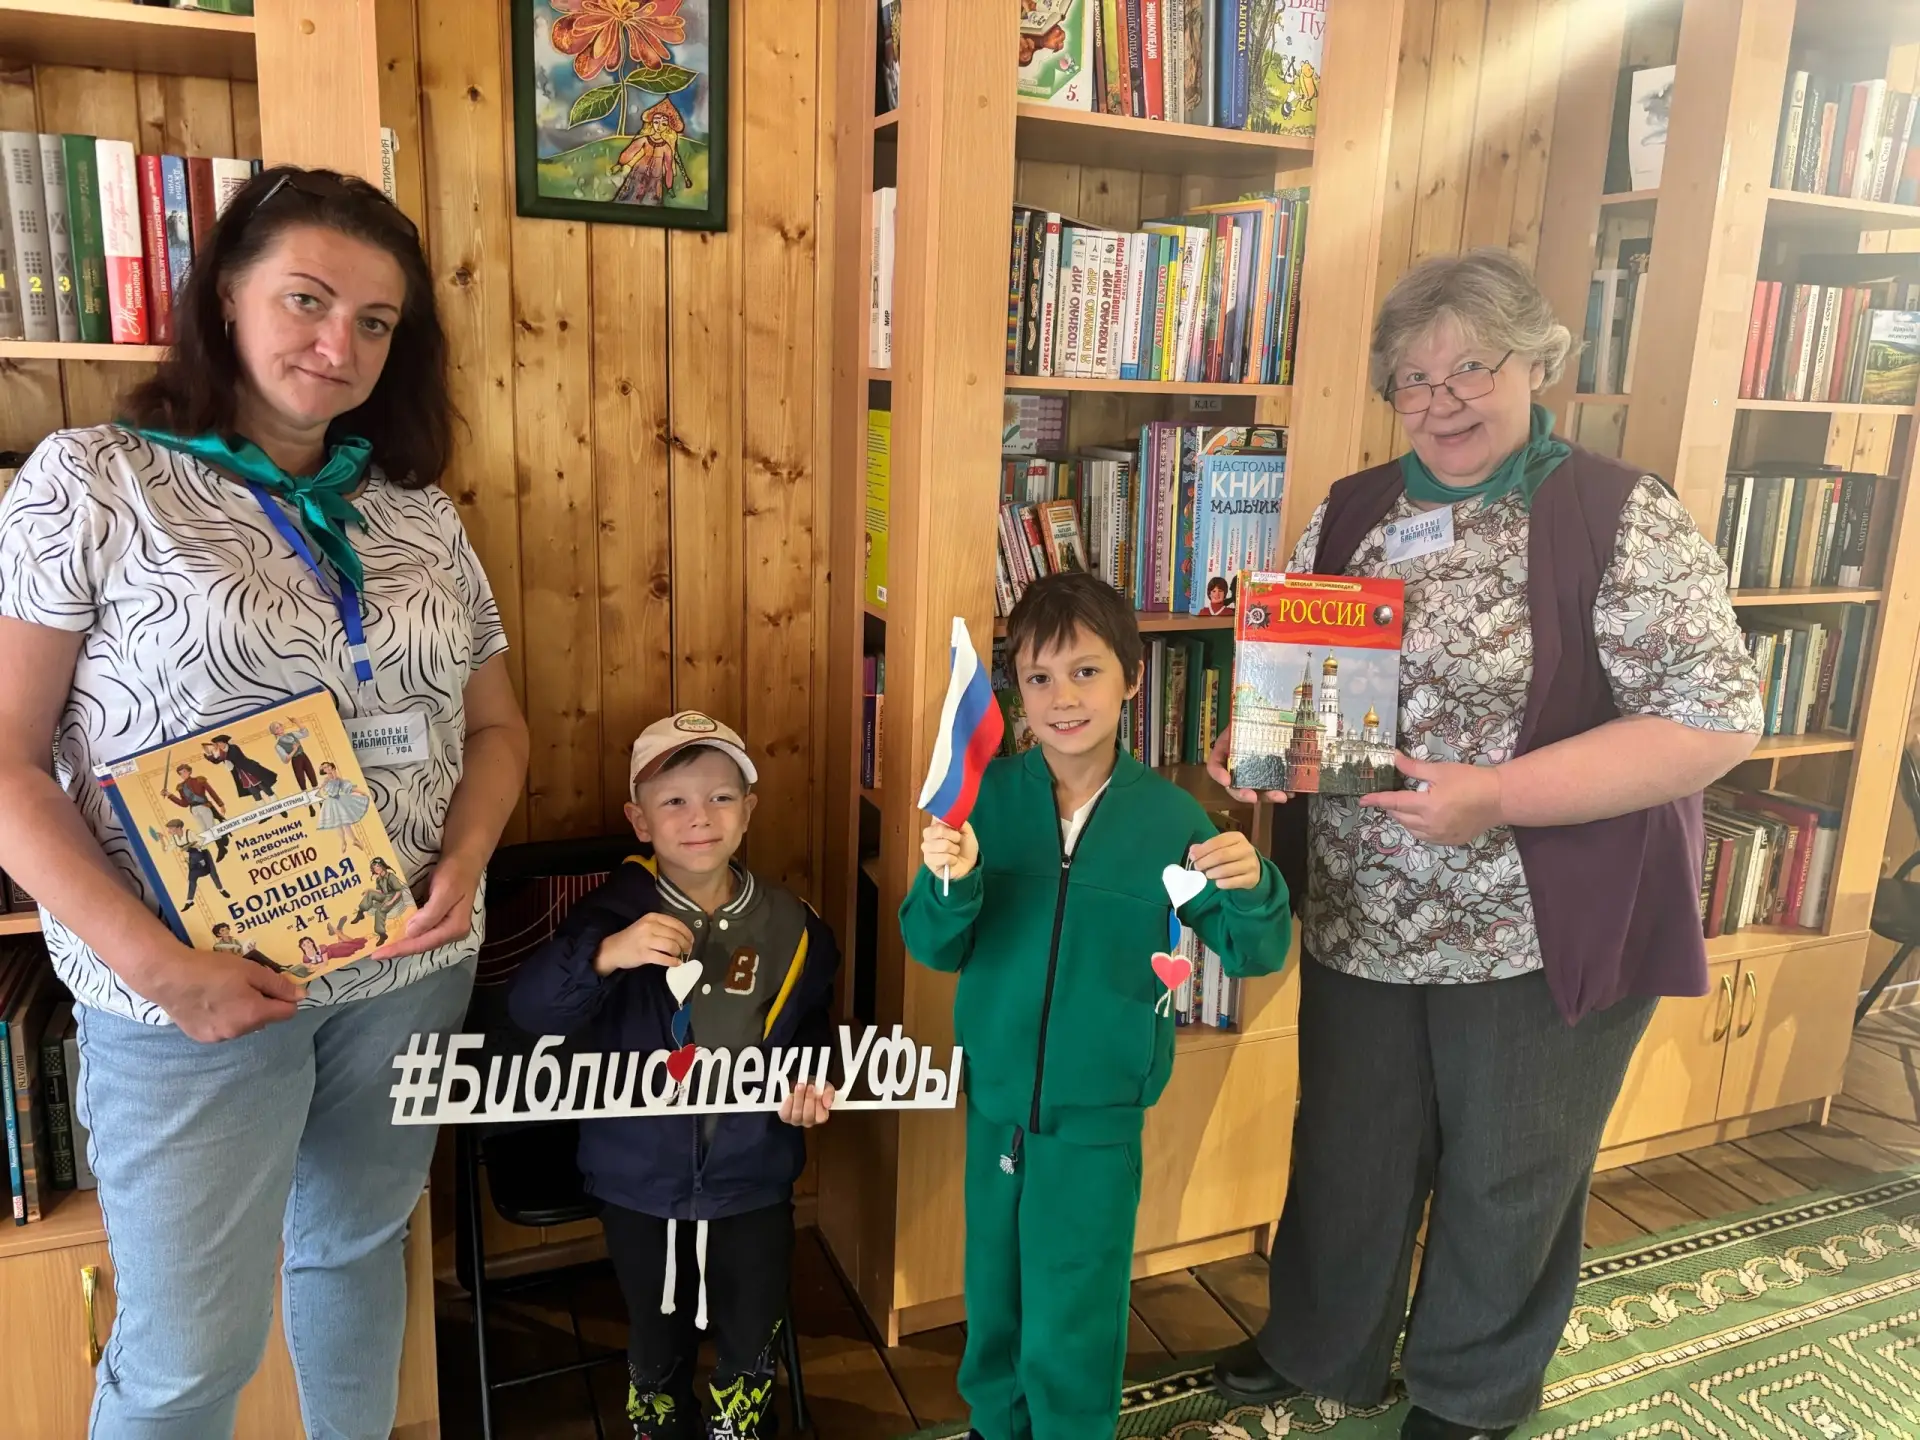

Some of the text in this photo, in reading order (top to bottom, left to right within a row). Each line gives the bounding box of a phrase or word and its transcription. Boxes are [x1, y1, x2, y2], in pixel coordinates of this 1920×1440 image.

[1145, 1, 1157, 59] ЭНЦИКЛОПЕДИЯ
[28, 276, 43, 293] 2
[58, 276, 71, 292] 3
[1111, 237, 1125, 326] ЗАПОВЕДНЫЙ ОСТРОВ
[1065, 265, 1082, 362] Я ПОЗНАЮ МИР
[1080, 267, 1098, 365] Я ПОЗНАЮ МИР
[1096, 270, 1113, 367] Я ПОЗНАЮ МИР
[1154, 265, 1167, 349] АГНИЯ БАРТО
[1212, 460, 1285, 473] НАСТОЛЬН
[1211, 471, 1284, 499] КНИГ
[1401, 519, 1440, 535] МАССОВЫЕ
[1401, 526, 1440, 543] БИБЛИОТЕКИ
[1278, 598, 1367, 627] РОССИЯ
[351, 726, 409, 740] МАССОВЫЕ
[352, 734, 409, 749] БИБЛИОТЕКИ
[396, 745, 412, 754] УФА
[235, 820, 302, 850] Мальчики
[240, 831, 307, 861] и девочки,
[248, 847, 317, 885] РОССИЮ
[228, 857, 355, 920] БОЛЬШАЯ
[235, 874, 361, 934] ЭНЦИКЛОПЕДИЯ
[295, 915, 308, 932] А
[314, 905, 329, 923] Я
[16, 1055, 27, 1089] ПИРАТЫ
[14, 1197, 23, 1217] burda
